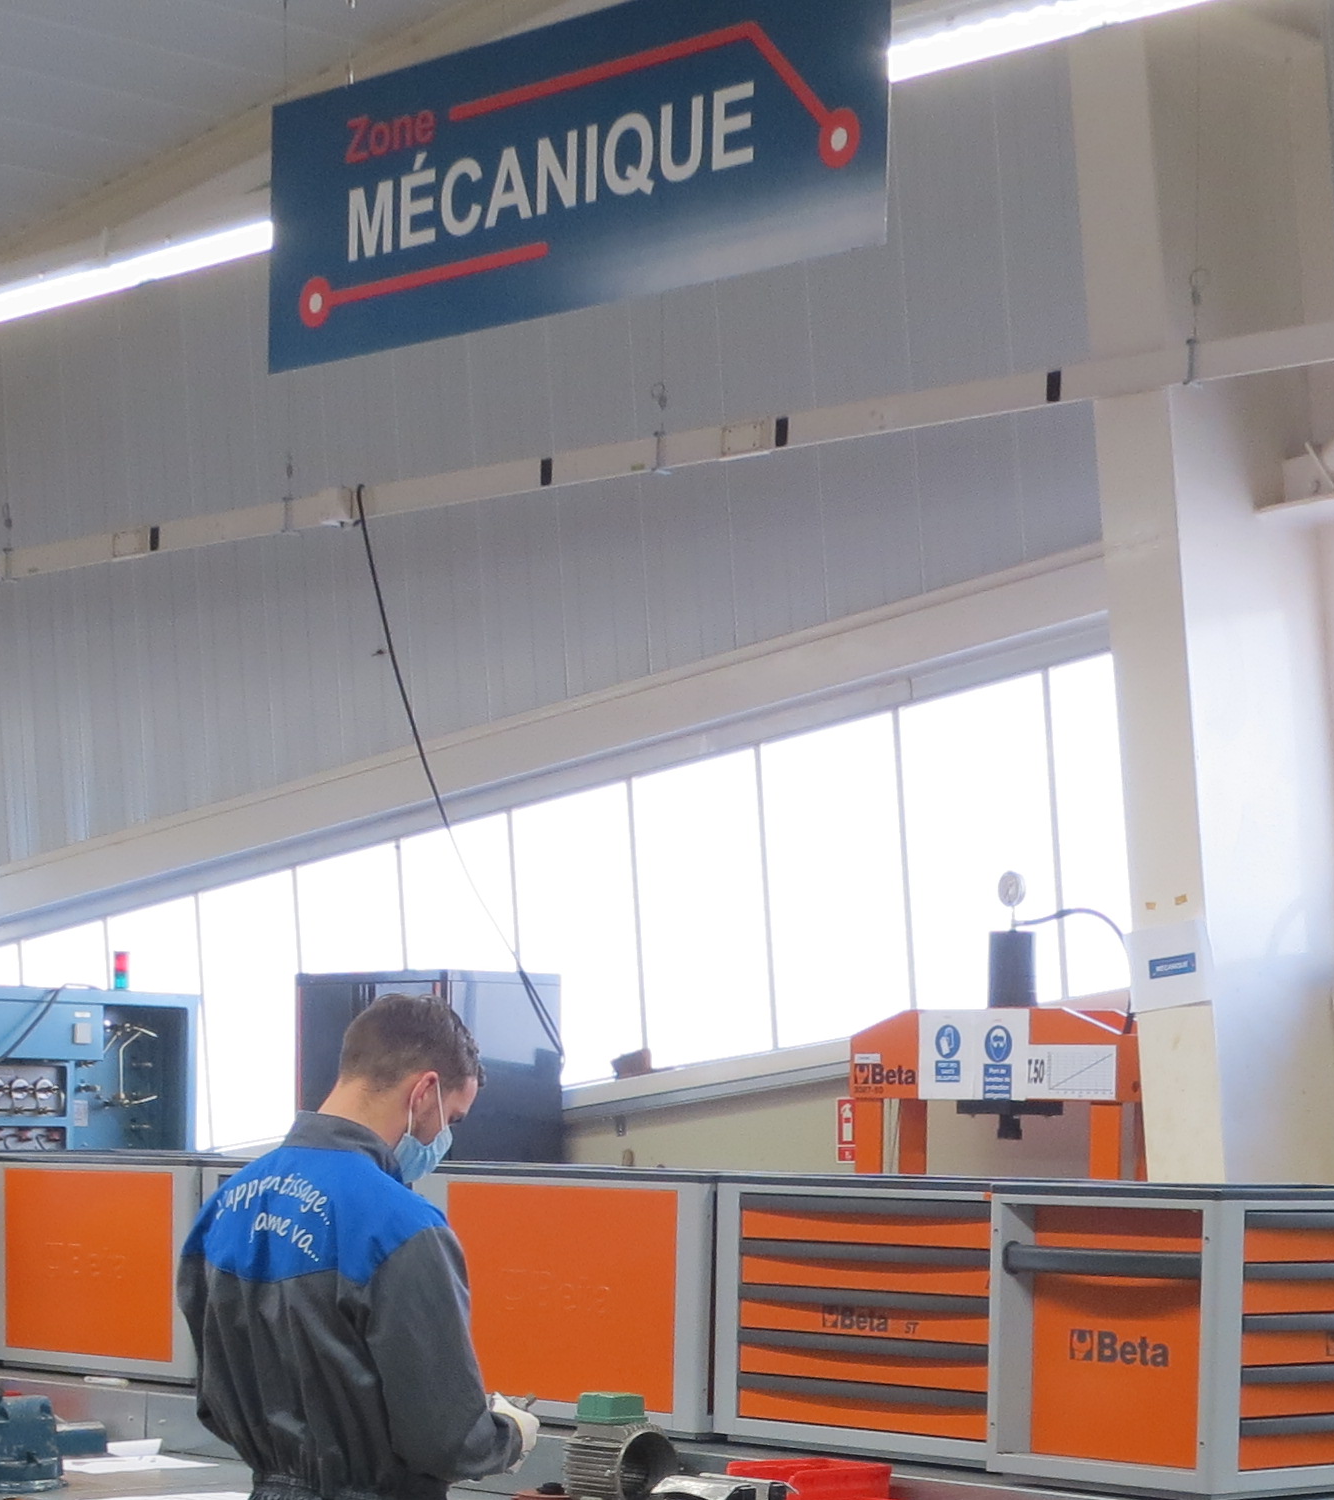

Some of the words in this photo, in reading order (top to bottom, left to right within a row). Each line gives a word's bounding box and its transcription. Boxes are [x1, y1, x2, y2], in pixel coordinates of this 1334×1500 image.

[344, 108, 435, 164] Zone
[347, 80, 755, 262] MÉCANIQUE
[871, 1063, 916, 1085] Beta
[840, 1306, 889, 1332] Beta
[904, 1321, 919, 1334] ST
[1097, 1331, 1168, 1368] Beta
